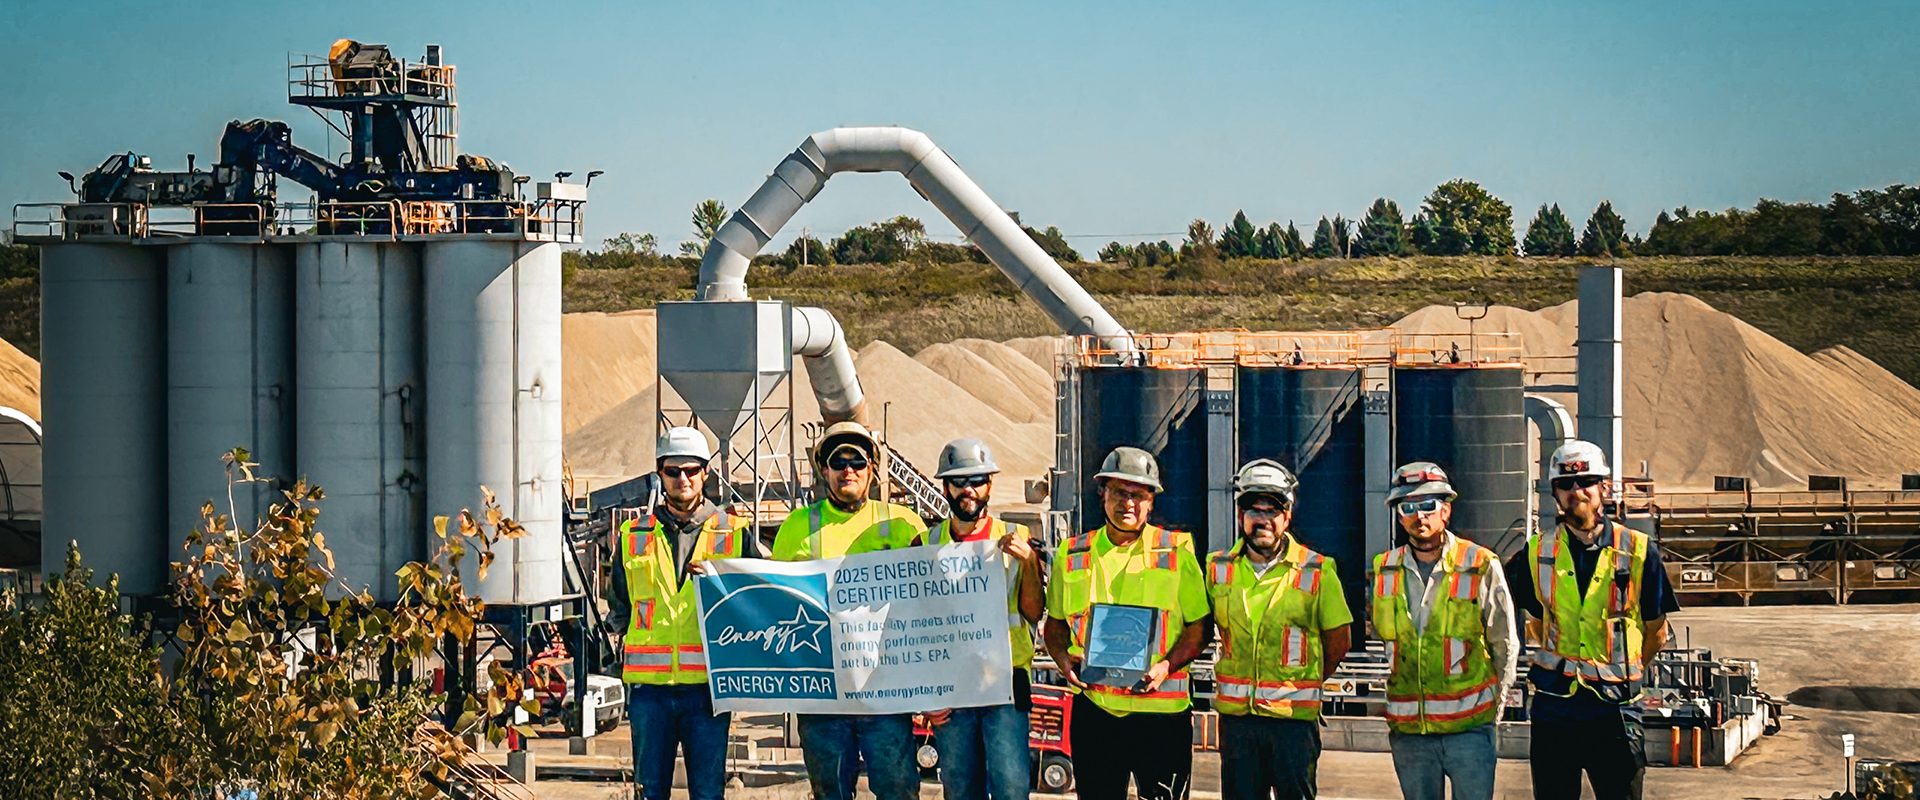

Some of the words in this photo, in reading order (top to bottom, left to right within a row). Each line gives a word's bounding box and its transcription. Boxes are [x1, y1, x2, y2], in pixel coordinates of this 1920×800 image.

[835, 567, 869, 584] 2025
[874, 559, 934, 581] ENERGY
[940, 554, 982, 573] STAR
[836, 582, 919, 605] CERTIFIED
[923, 575, 989, 598] FACILITY
[839, 621, 864, 634] This
[867, 617, 907, 631] faclity
[911, 616, 944, 628] meets
[946, 612, 975, 625] strict
[709, 625, 801, 654] energy
[958, 627, 992, 642] levels
[880, 652, 899, 666] the
[716, 675, 785, 694] ENERGY
[789, 675, 833, 694] STAR
